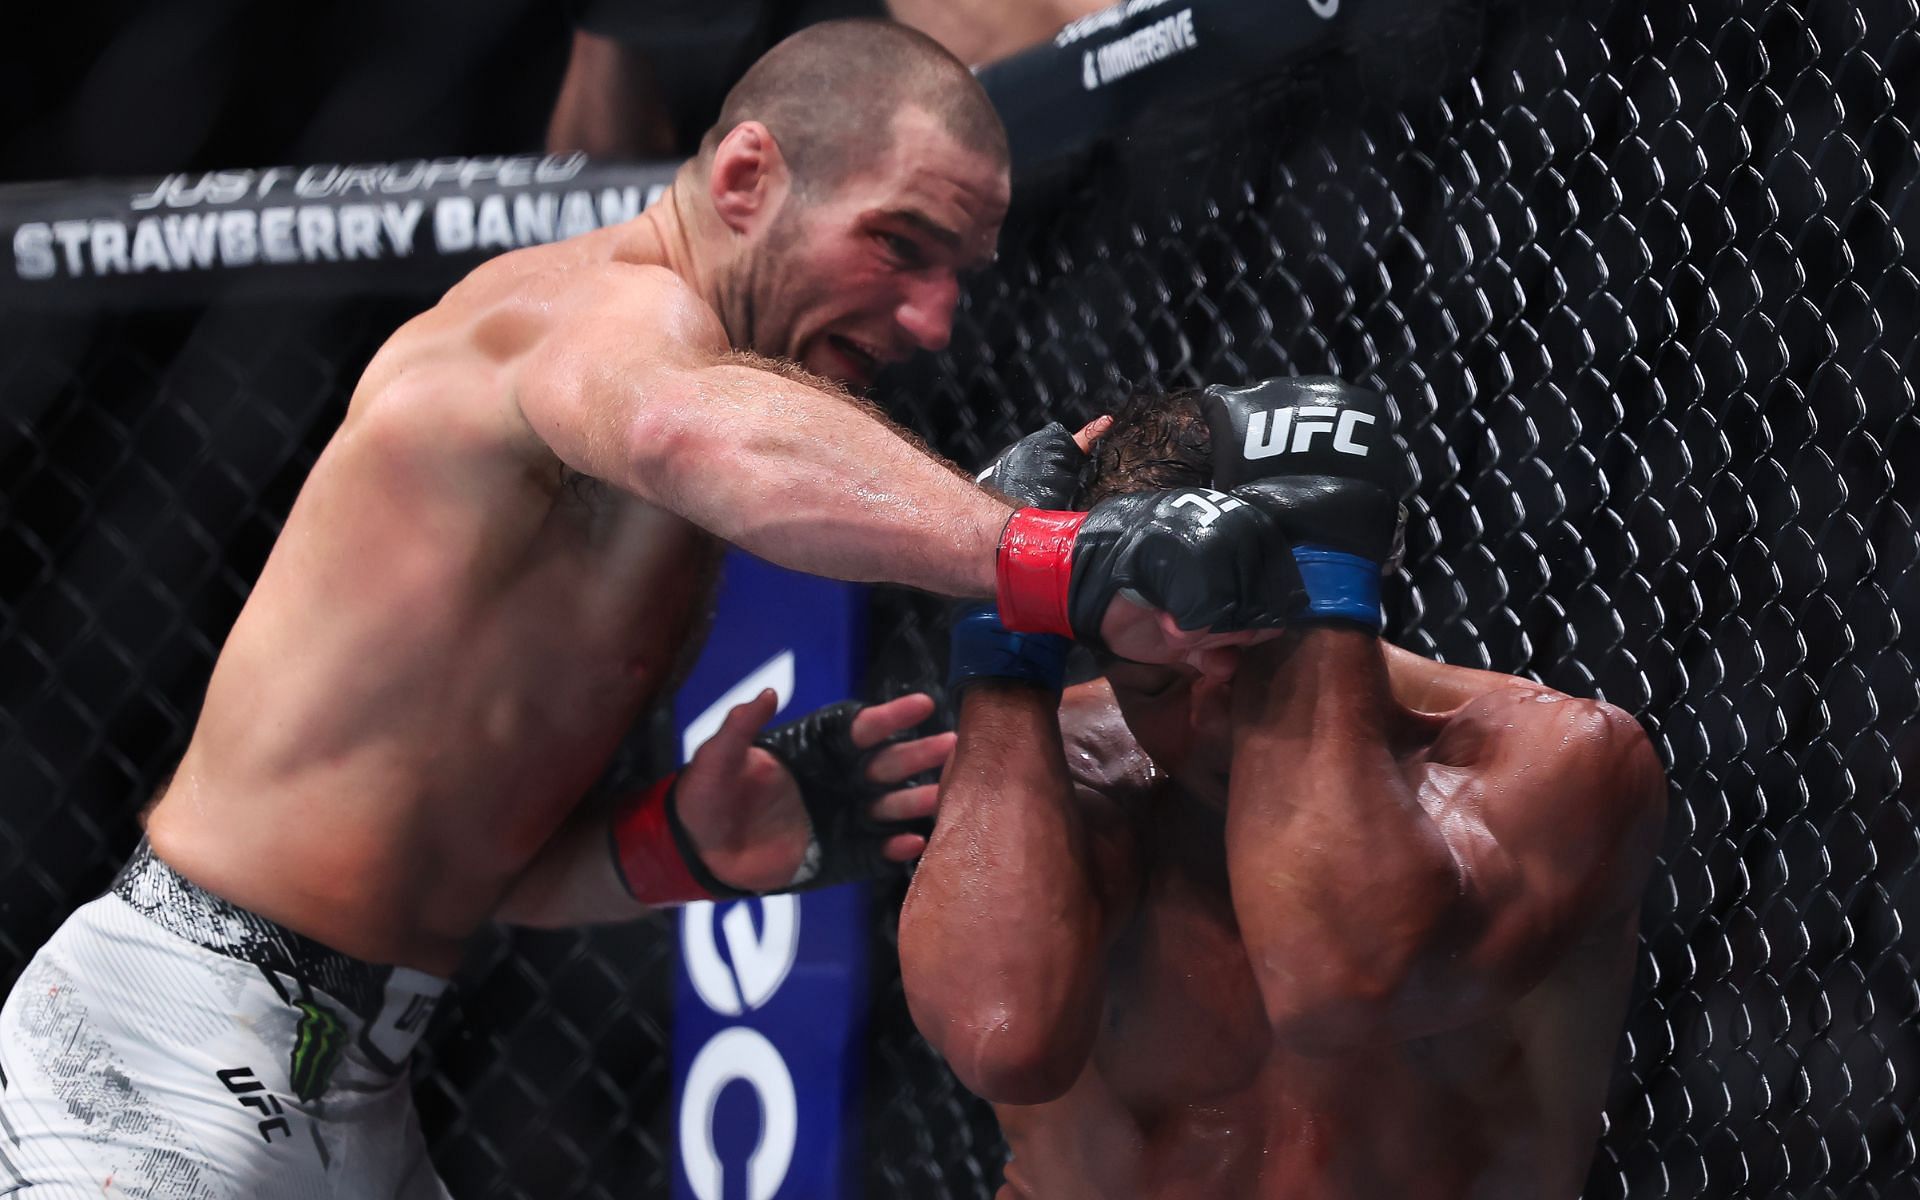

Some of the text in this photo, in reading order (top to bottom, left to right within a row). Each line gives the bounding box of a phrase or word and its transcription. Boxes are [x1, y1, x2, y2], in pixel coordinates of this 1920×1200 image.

[130, 167, 296, 211] JUST
[13, 200, 424, 280] STRAWBERRY
[1243, 405, 1376, 461] UFC
[216, 1066, 292, 1144] UFC
